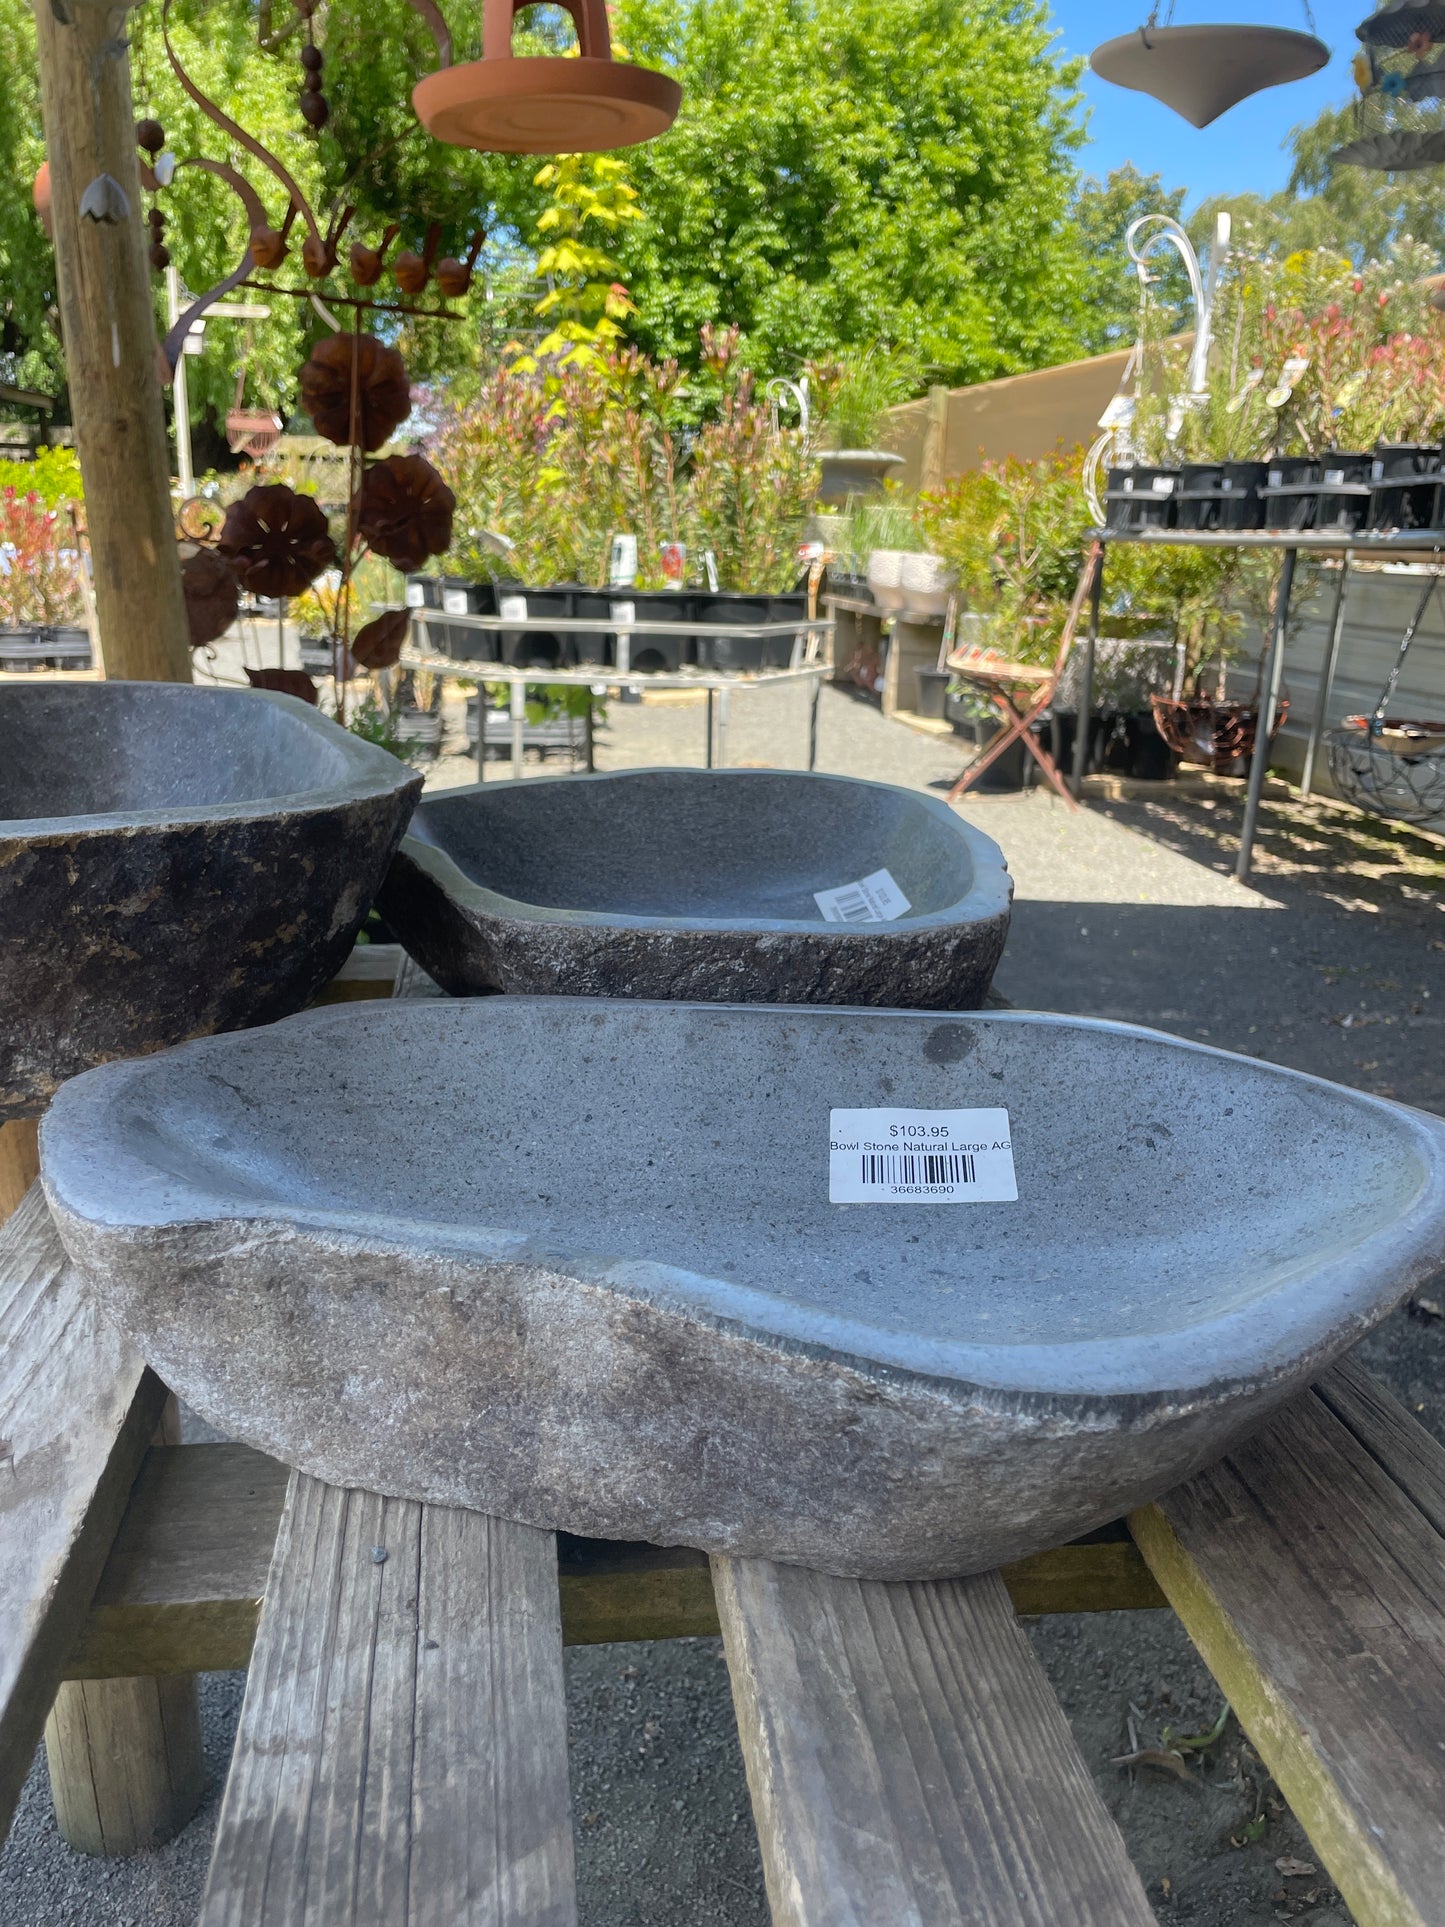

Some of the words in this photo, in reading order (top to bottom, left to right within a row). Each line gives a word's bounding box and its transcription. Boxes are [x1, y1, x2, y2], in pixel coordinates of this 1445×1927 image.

[890, 1125, 949, 1137] $103.95
[830, 1141, 859, 1151] Bowl
[863, 1142, 899, 1151] Stone
[903, 1142, 948, 1151] Natural
[952, 1142, 988, 1153] Large
[991, 1141, 1011, 1150] AG
[890, 1185, 954, 1194] 36683690
